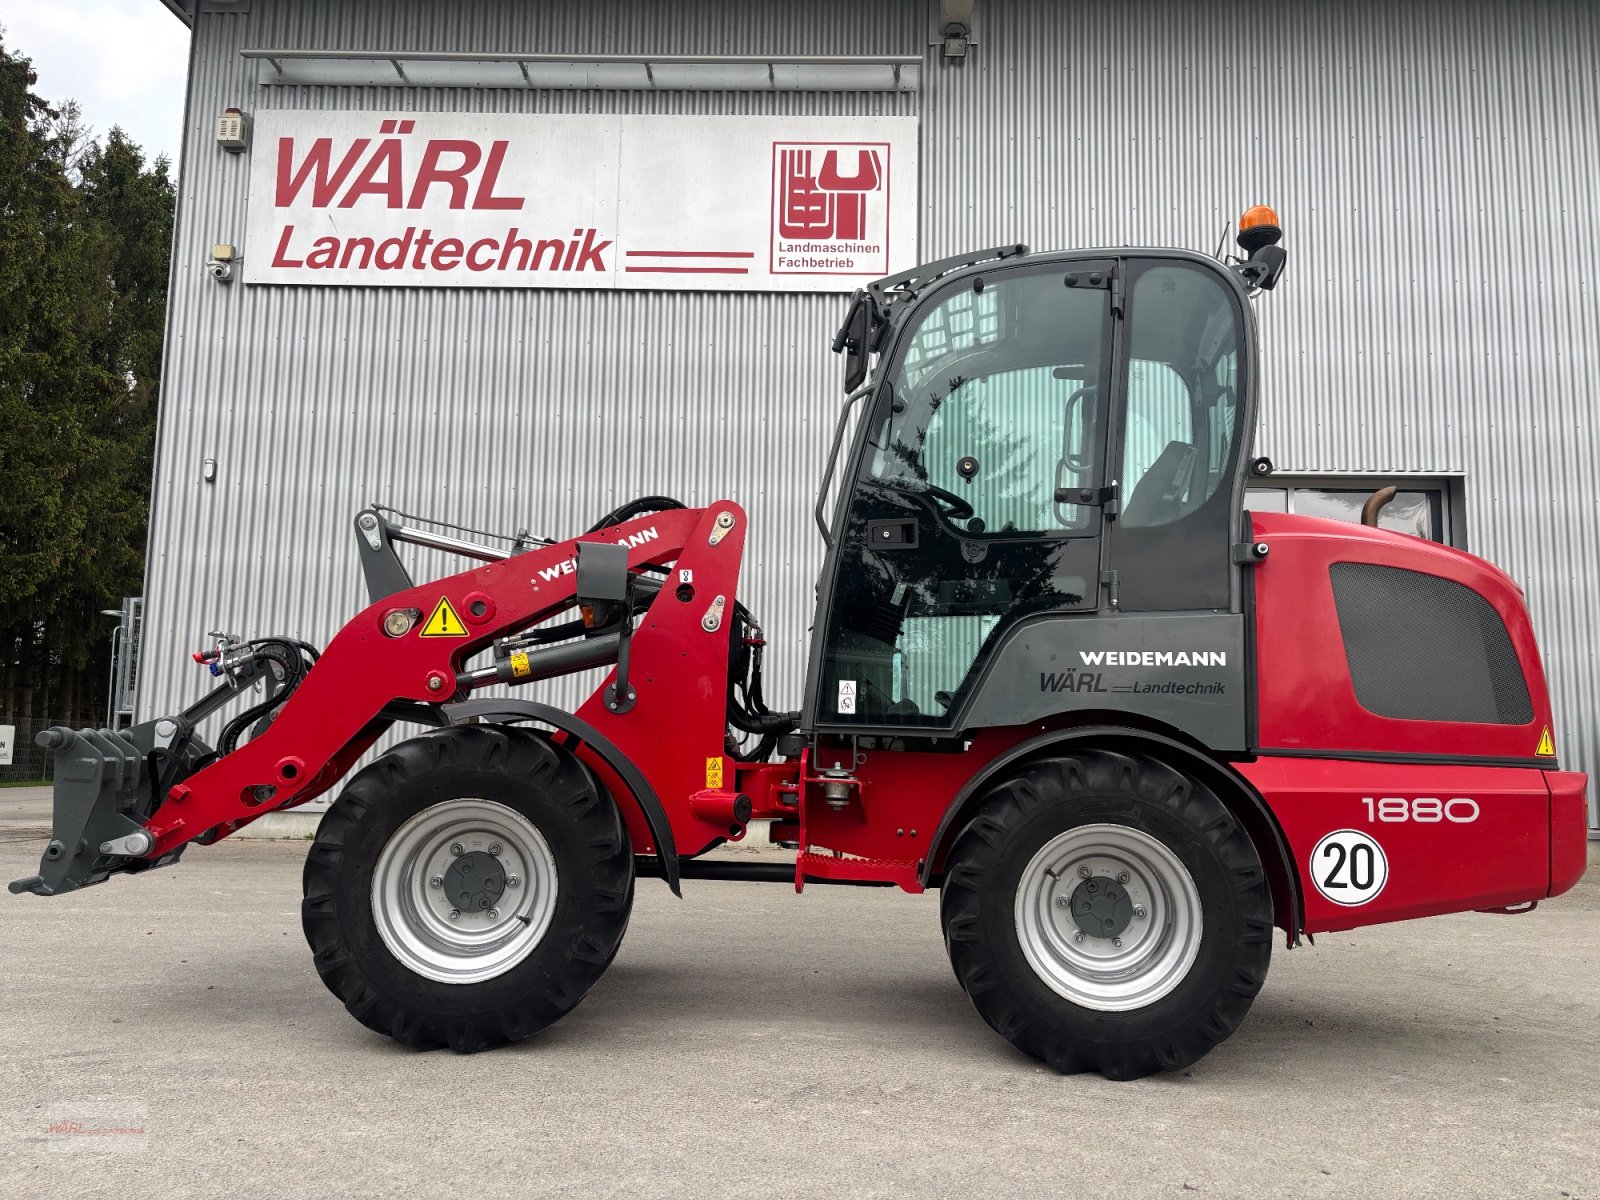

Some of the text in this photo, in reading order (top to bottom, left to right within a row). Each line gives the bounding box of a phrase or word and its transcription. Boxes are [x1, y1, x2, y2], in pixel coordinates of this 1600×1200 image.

[275, 119, 525, 210] WÄRL
[271, 225, 613, 272] Landtechnik
[779, 242, 880, 253] Landmaschinen
[778, 256, 854, 268] Fachbetrieb
[1079, 651, 1227, 667] WEIDEMANN
[1039, 668, 1226, 695] WÄRL Landtechnik
[1362, 797, 1480, 823] 1880
[1323, 842, 1375, 890] 20
